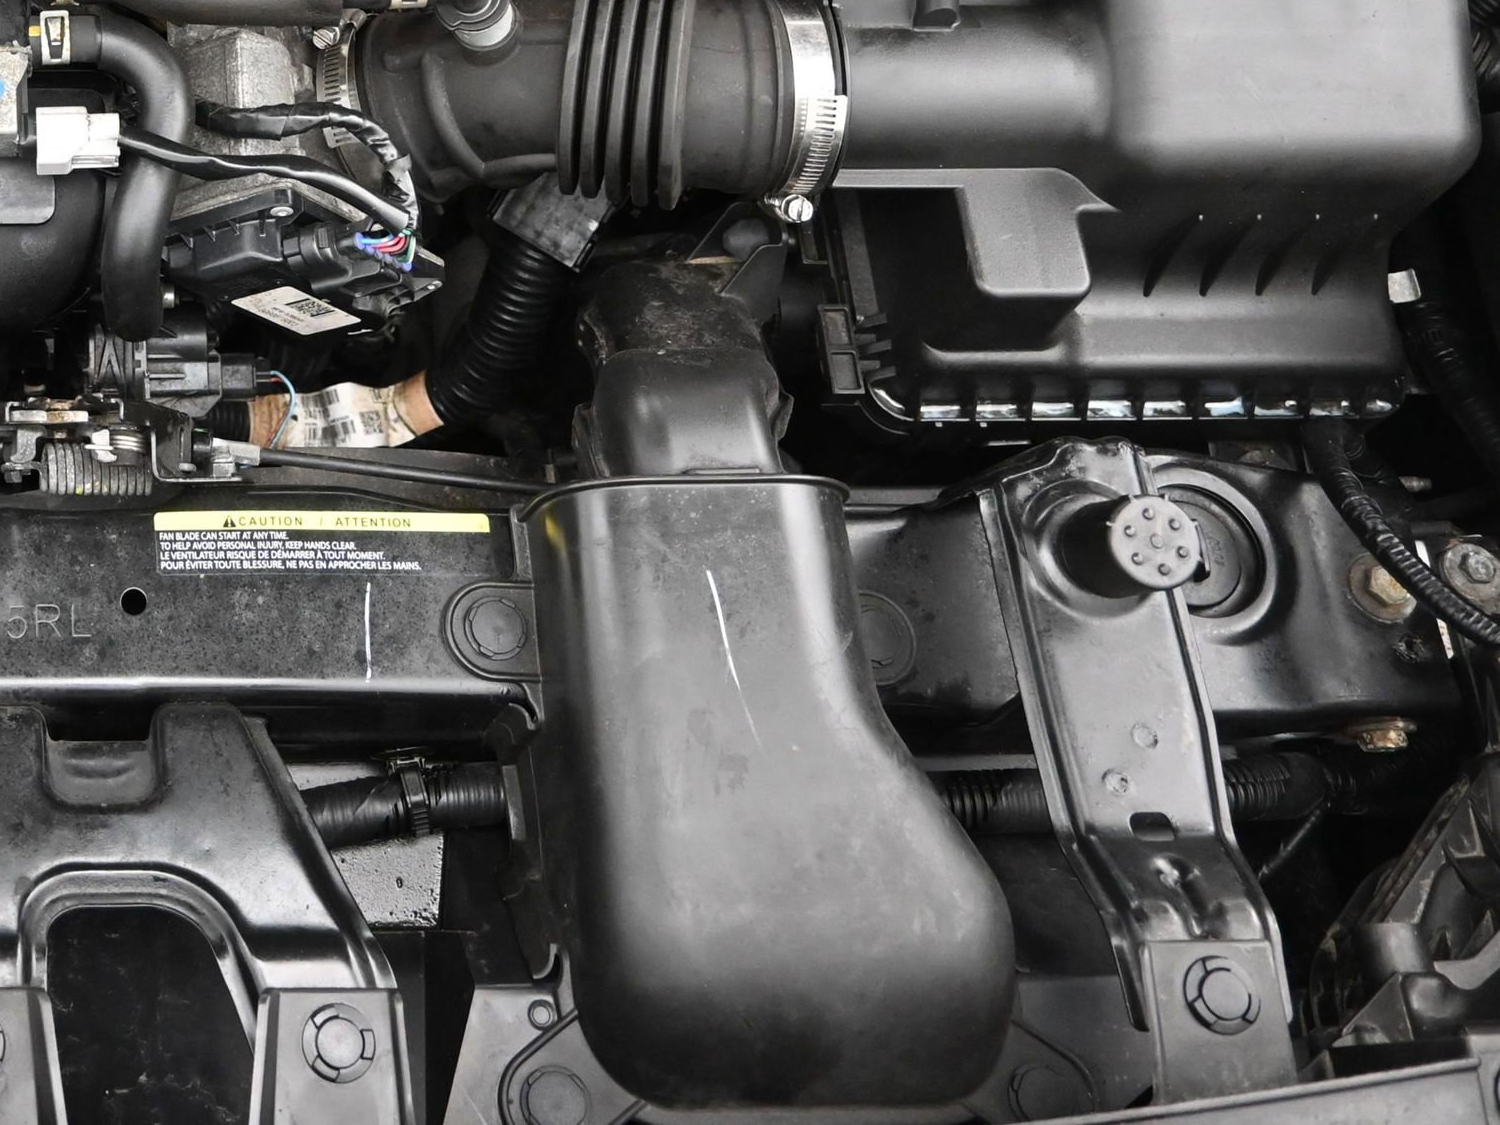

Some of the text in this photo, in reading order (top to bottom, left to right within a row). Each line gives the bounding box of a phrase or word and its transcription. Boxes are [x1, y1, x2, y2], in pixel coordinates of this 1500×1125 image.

[239, 516, 304, 527] CAUTION
[335, 517, 412, 528] ATTENTION
[160, 531, 289, 541] FAN BLADE CAN START AT ANY TIME.
[160, 541, 357, 551] TO HELP AVOID PERSONAL INJURY, KEEP HANDS CLEAR.
[160, 551, 170, 561] LE
[171, 551, 225, 561] VENTILATEUR
[226, 551, 257, 561] RISQUE
[258, 551, 270, 561] DE
[271, 549, 315, 561] DÉMARRER
[324, 551, 347, 561] TOUT
[347, 551, 386, 561] MOMENT.
[161, 559, 422, 570] POUR ÉVITER TOUTE BLESSURE, NE PAS EN APPROCHER LES MAINS.
[7, 604, 92, 639] 5RL
